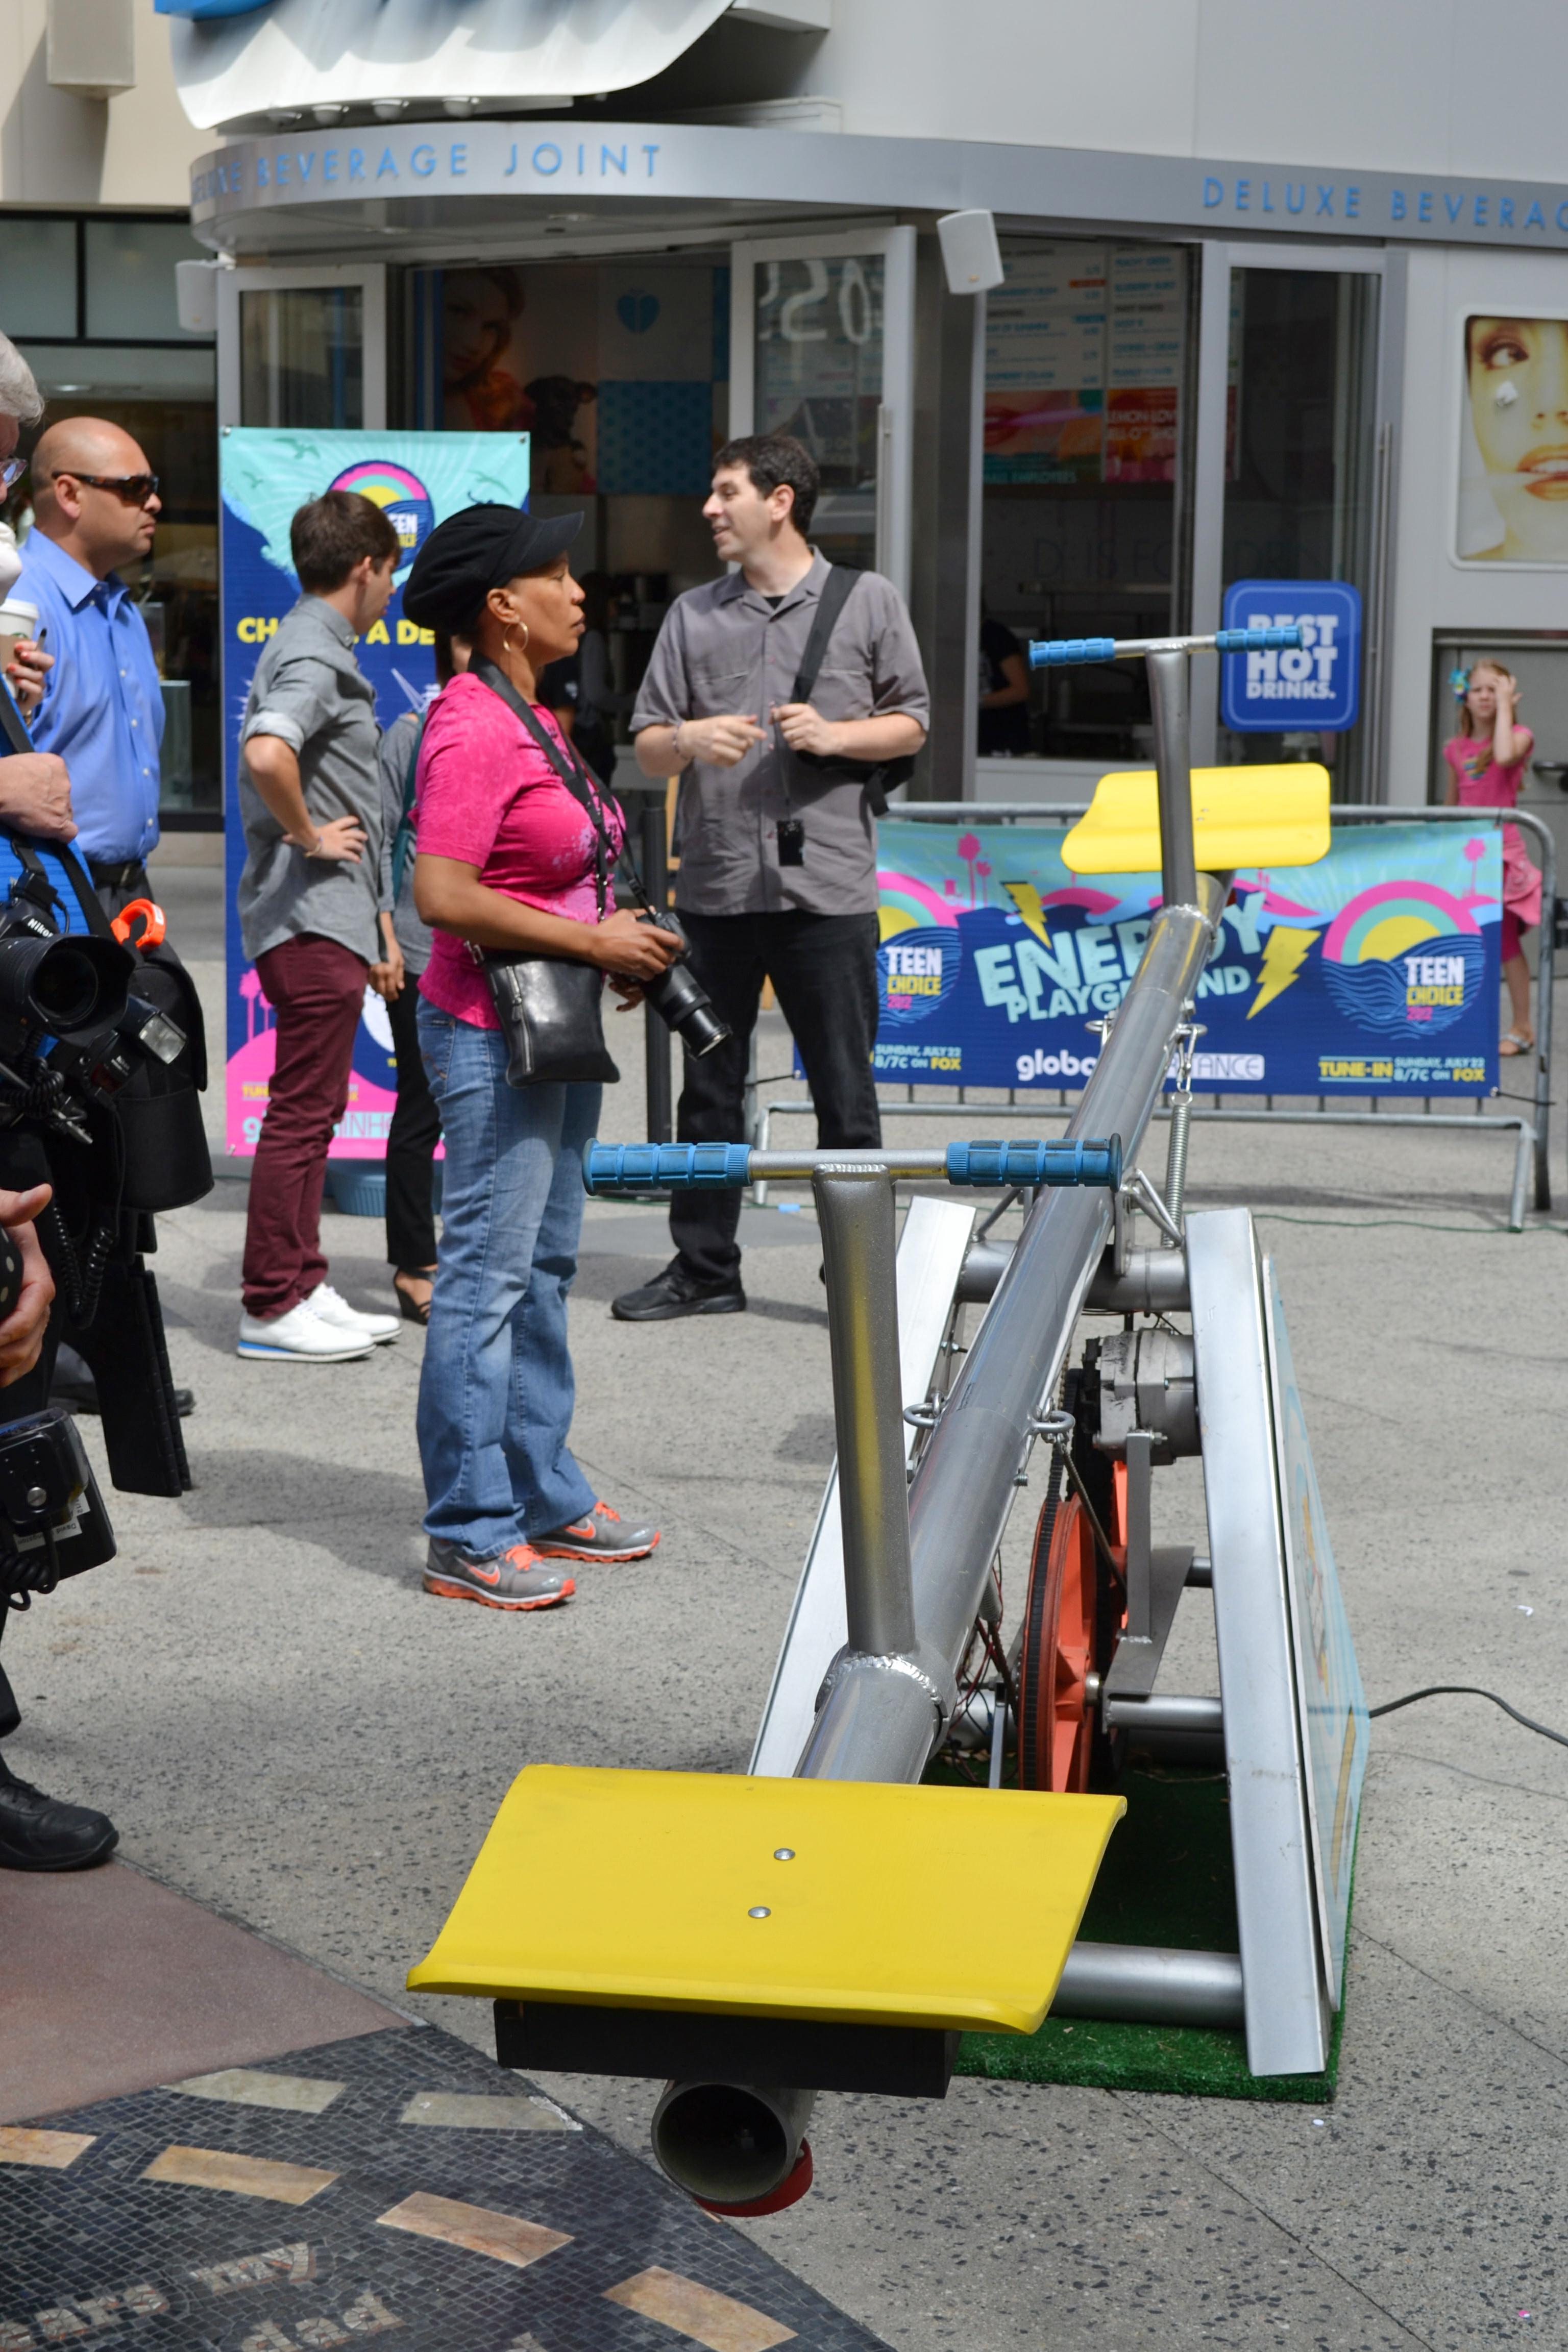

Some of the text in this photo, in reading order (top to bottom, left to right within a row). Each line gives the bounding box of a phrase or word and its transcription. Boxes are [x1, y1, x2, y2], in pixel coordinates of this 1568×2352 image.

[257, 143, 468, 187] BEVERAGE
[504, 142, 661, 176] JOINT
[1203, 177, 1361, 217] DELUXE
[365, 618, 390, 645] A
[1246, 647, 1338, 681] HOT
[1246, 680, 1337, 700] DRINKS.
[885, 946, 942, 975] TEEN
[1404, 956, 1464, 986] TEEN
[887, 975, 942, 996] CHOICE
[1406, 985, 1463, 1006] CHOICE
[930, 1057, 962, 1071] FOX
[1016, 1048, 1100, 1081] globa
[1319, 1061, 1393, 1077] TUNE-IN
[1453, 1068, 1485, 1082] FOX
